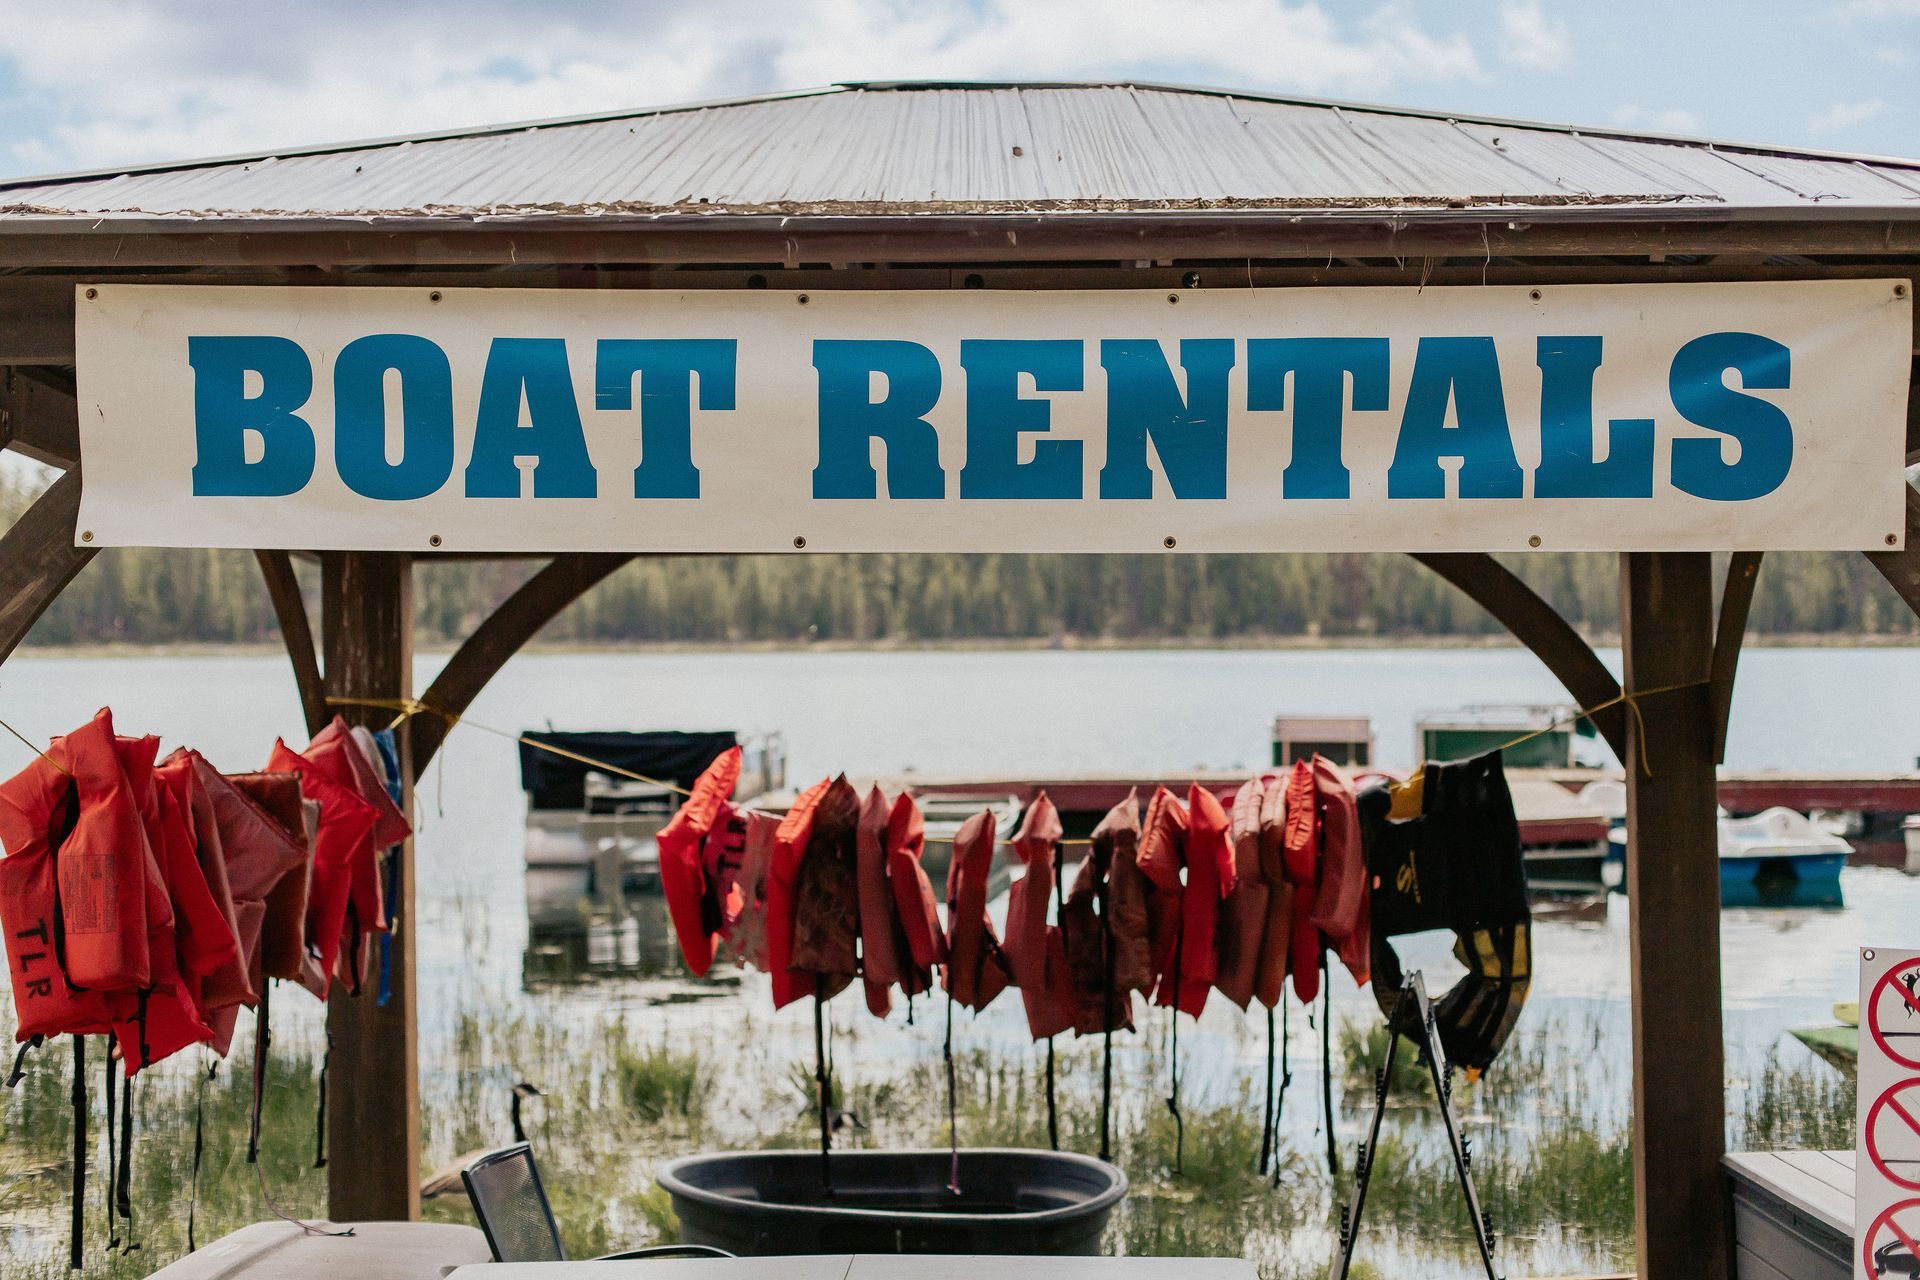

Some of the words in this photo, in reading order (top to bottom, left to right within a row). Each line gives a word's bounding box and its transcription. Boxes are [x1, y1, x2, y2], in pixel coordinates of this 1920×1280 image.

[189, 334, 738, 500] BOAT
[812, 331, 1794, 501] RENTALS
[717, 817, 748, 875] TLR
[16, 917, 52, 999] TLR
